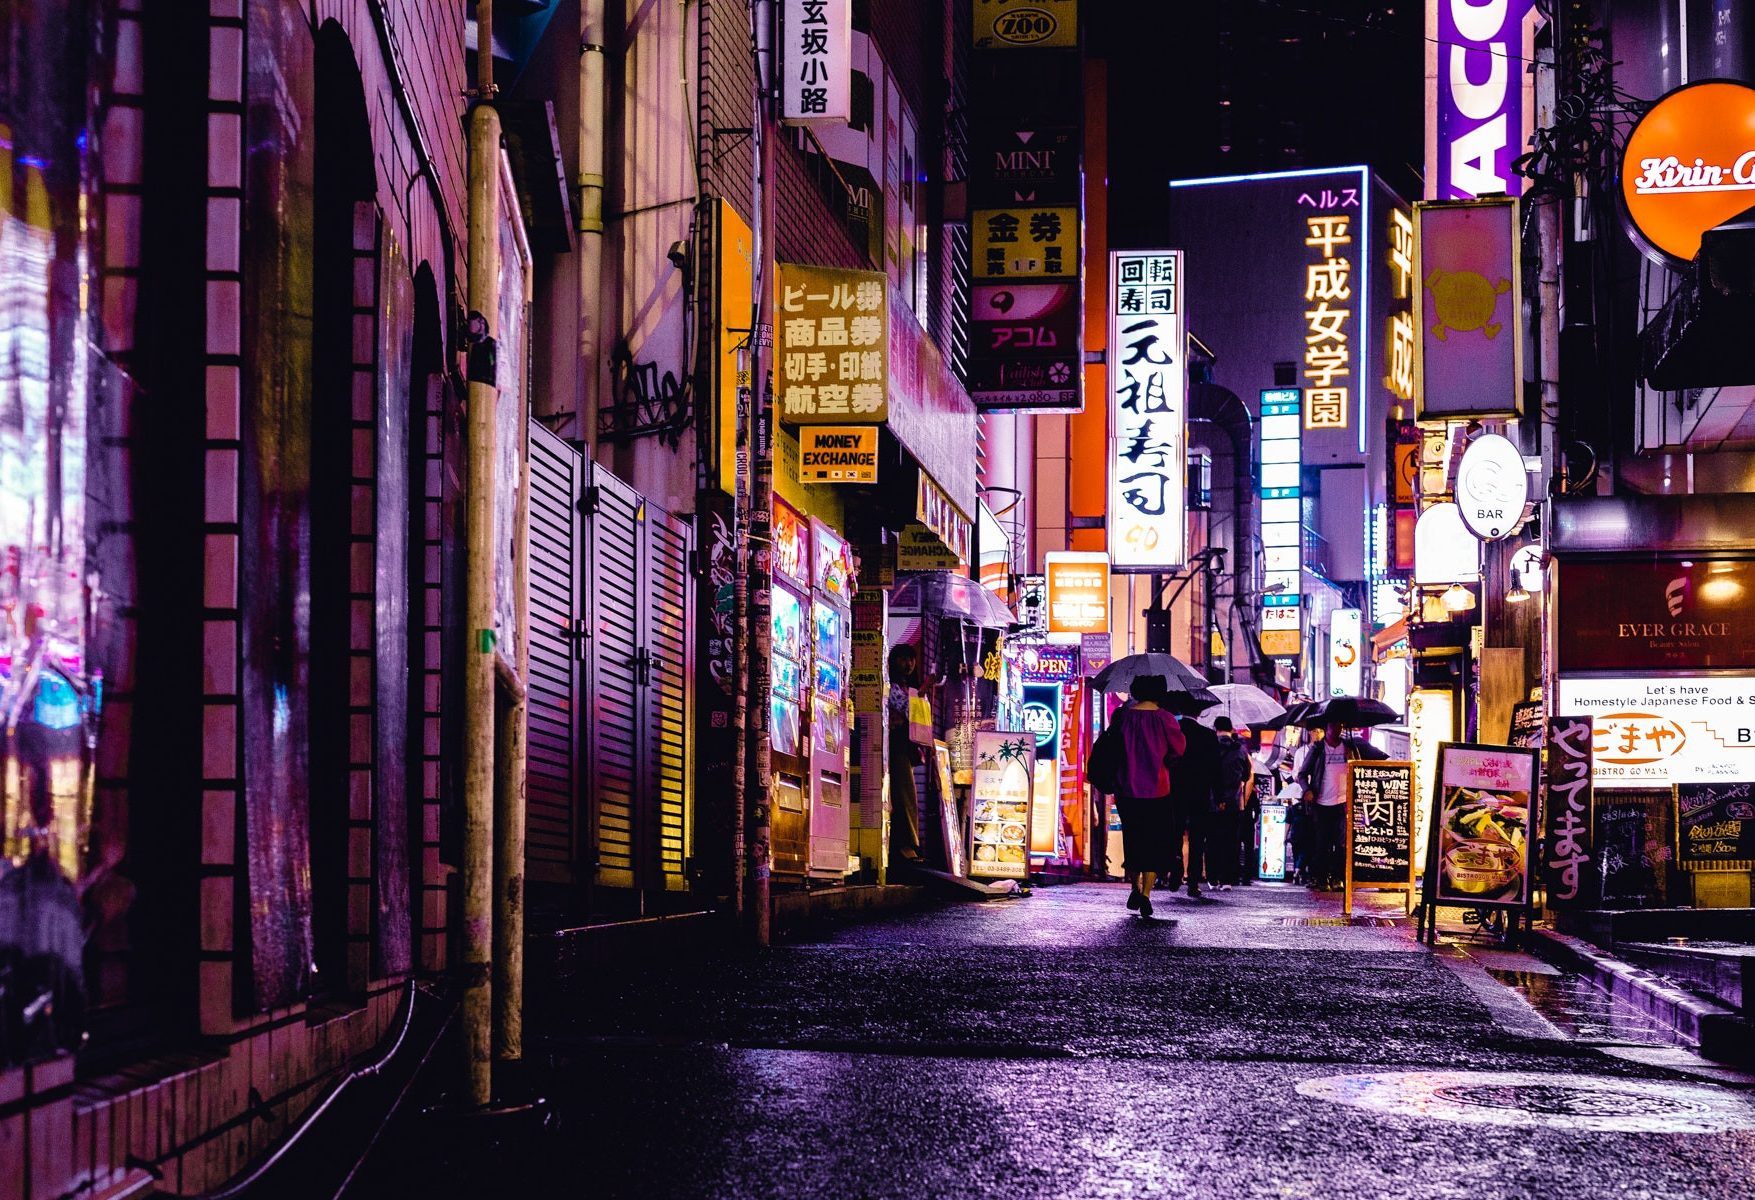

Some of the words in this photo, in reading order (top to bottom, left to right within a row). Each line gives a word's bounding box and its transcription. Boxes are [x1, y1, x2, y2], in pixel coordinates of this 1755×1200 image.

[1002, 17, 1050, 34] ZOO
[801, 0, 828, 114] 玄坂小路
[996, 151, 1055, 170] MINT
[1298, 188, 1360, 208] ヘルス
[987, 212, 1062, 243] 金券
[783, 281, 883, 312] ビール券
[785, 317, 882, 347] 商品券
[1303, 215, 1351, 430] 平成女学園
[991, 326, 1058, 349] アコム
[785, 385, 884, 415] 航空券
[1116, 319, 1175, 515] 元祖寿司
[814, 434, 862, 448] MONEY
[803, 452, 875, 466] EXCHANGE
[1477, 509, 1503, 519] BAR
[1619, 623, 1665, 637] EVER
[1670, 622, 1731, 637] GRACE
[1028, 659, 1070, 674] OPEN
[1680, 686, 1709, 695] have
[1574, 697, 1637, 709] Homestyle
[1641, 697, 1698, 708] Japanese
[1702, 696, 1732, 706] Food
[1737, 696, 1745, 705] &
[1023, 709, 1048, 721] TAX
[1593, 723, 1676, 754] ごまや
[1592, 767, 1625, 776] BISTRO
[1382, 780, 1409, 790] WINE
[1363, 792, 1394, 826] 肉
[1549, 719, 1591, 900] やってます
[1364, 827, 1394, 836] ビストロ
